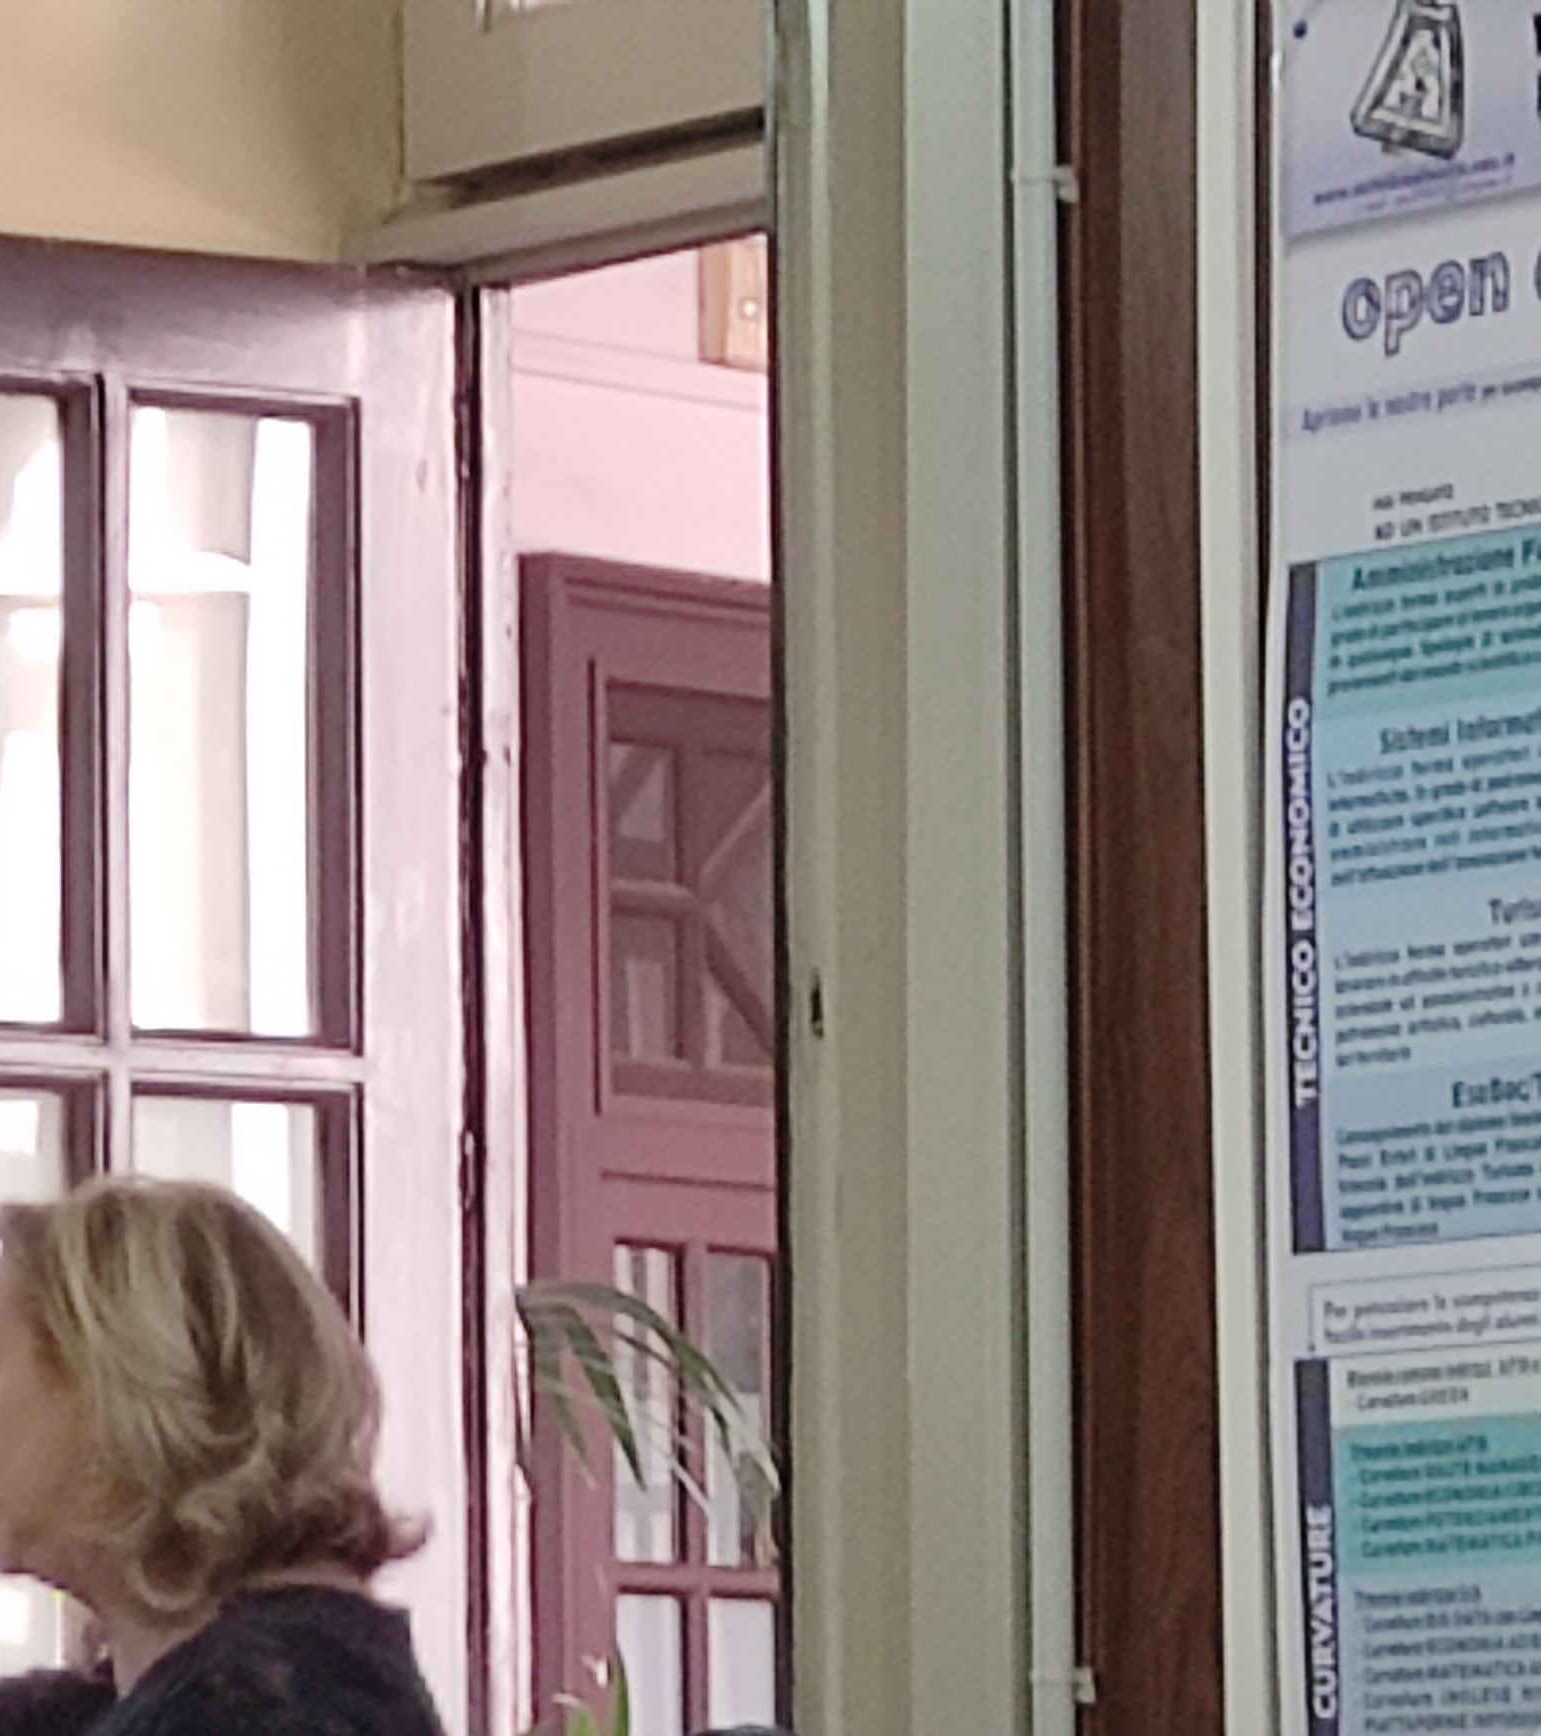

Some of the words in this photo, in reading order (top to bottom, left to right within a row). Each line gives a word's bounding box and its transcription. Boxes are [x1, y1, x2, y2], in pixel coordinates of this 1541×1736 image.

[1342, 251, 1511, 357] open
[1285, 697, 1314, 931] ECONOMICO
[1290, 938, 1318, 1110] TECNICO
[1306, 1504, 1337, 1719] CURVATURE
